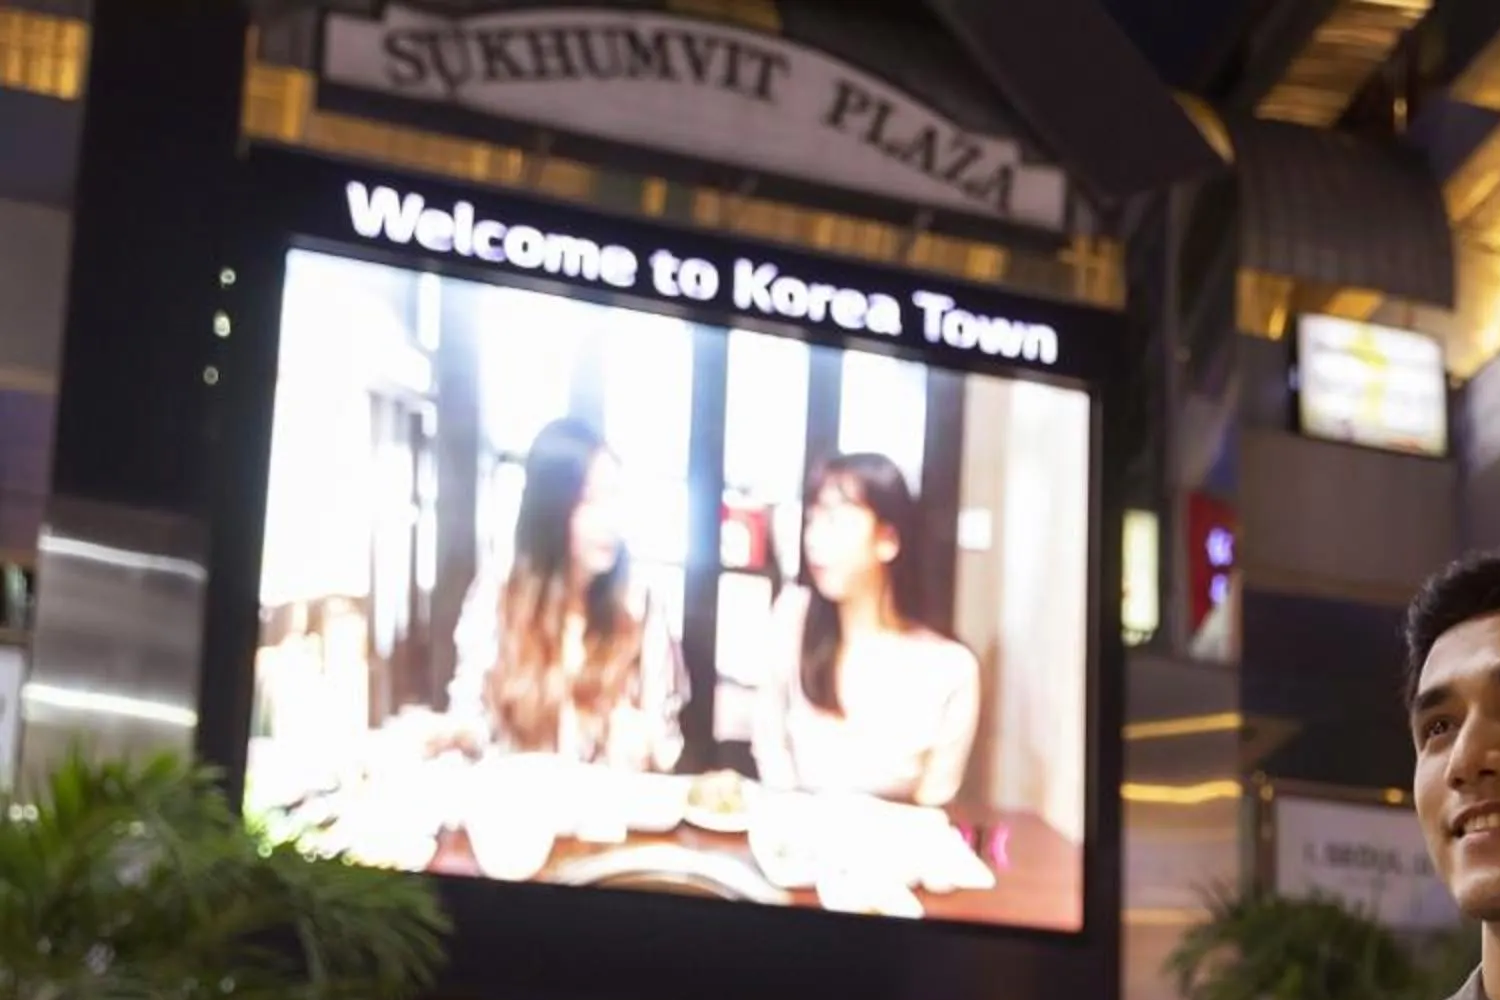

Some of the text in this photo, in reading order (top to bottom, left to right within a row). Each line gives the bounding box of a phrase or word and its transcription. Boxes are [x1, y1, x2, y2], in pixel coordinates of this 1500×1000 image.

[381, 24, 1016, 207] SUKHUMVIT PLAZA
[346, 180, 1058, 364] Welcome to Korea Town
